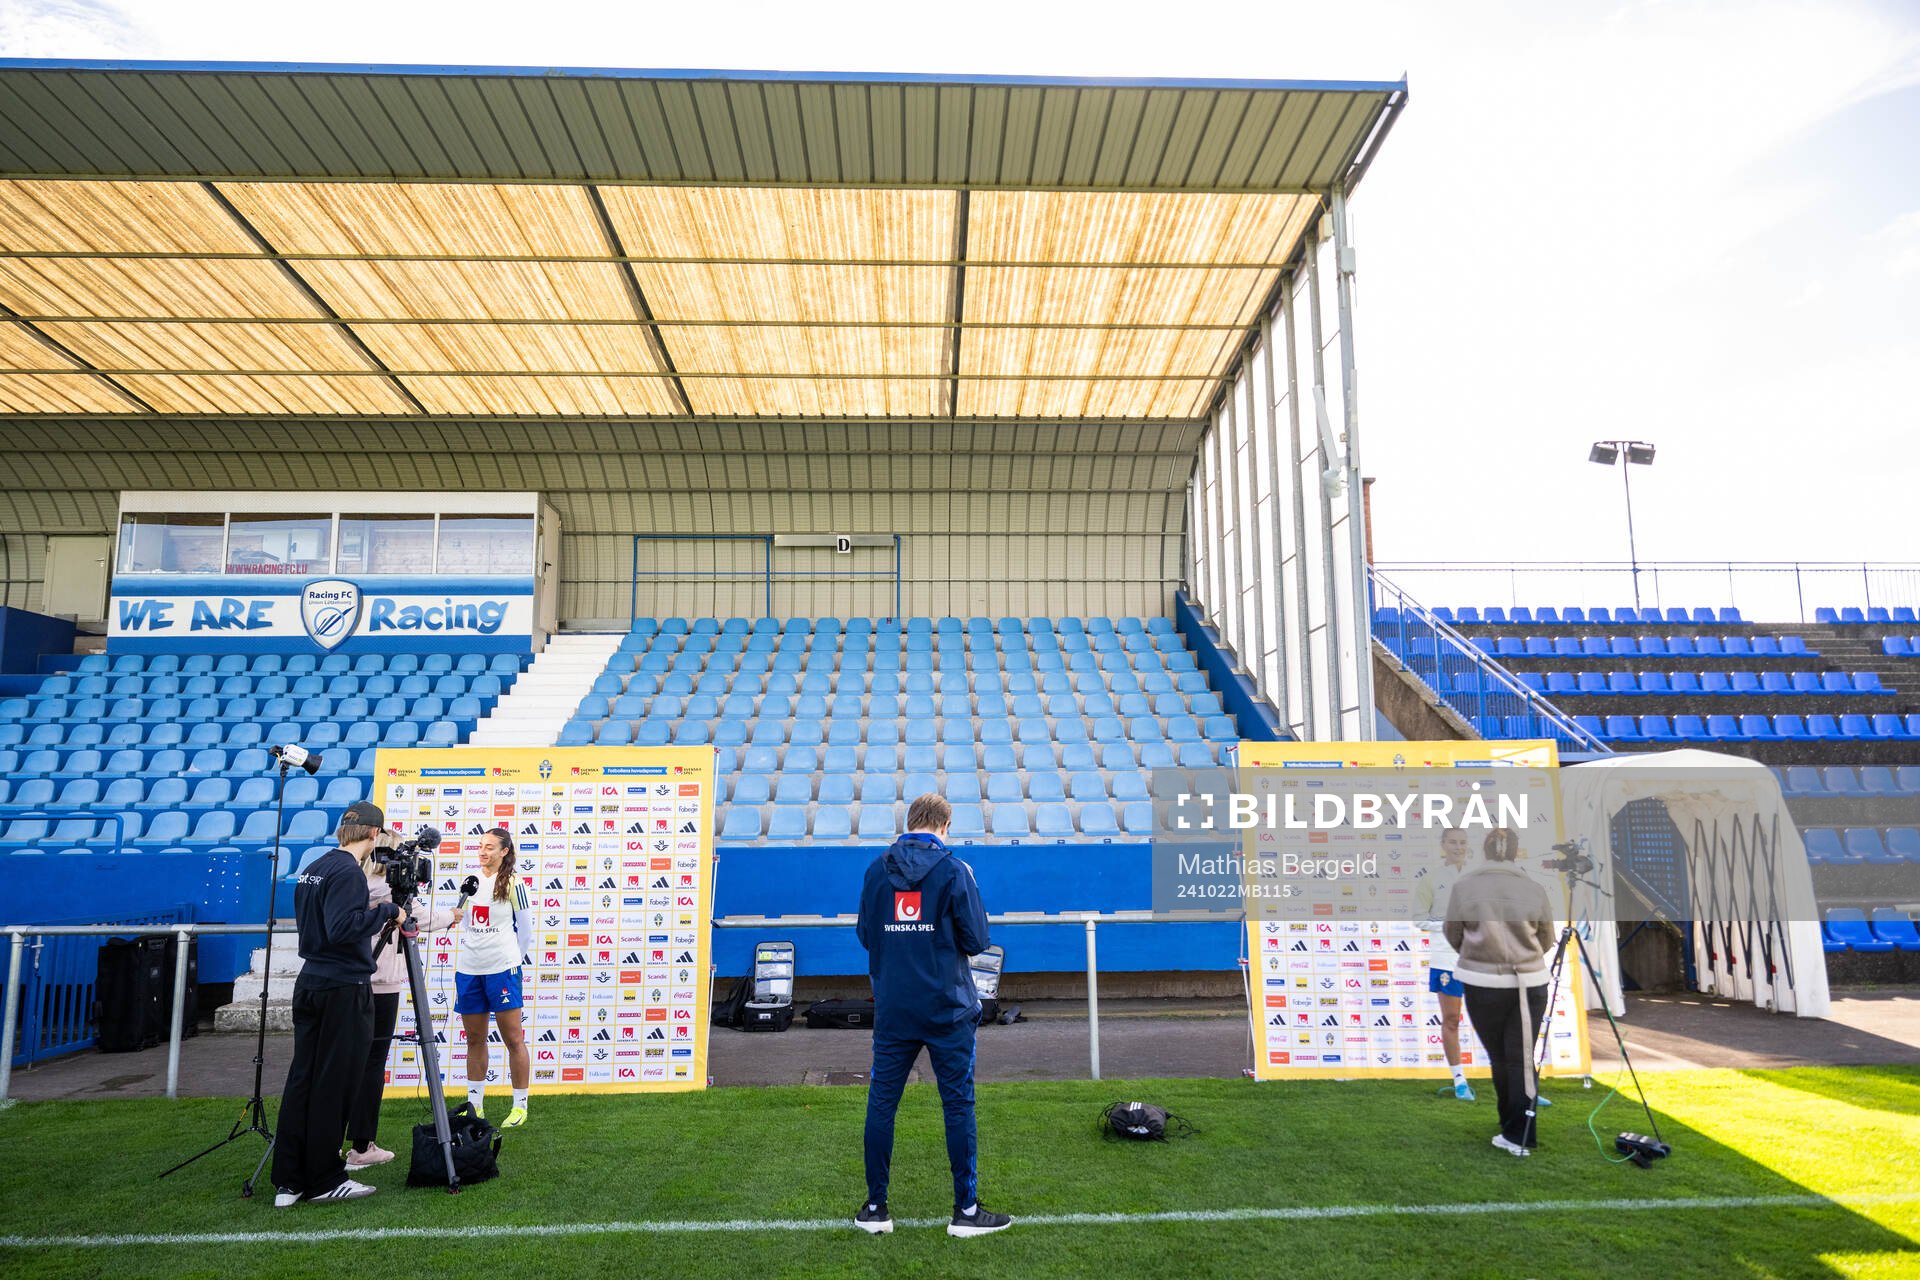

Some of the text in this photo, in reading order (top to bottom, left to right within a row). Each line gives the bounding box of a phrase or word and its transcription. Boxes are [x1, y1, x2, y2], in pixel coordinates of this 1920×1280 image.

[839, 538, 850, 551] D
[309, 591, 339, 600] Racing
[119, 597, 509, 634] WE ARE Racing
[602, 787, 618, 795] ICA
[627, 842, 643, 850] ICA
[544, 899, 560, 907] ICA
[678, 897, 694, 905] ICA
[884, 924, 916, 932] SVENSKA
[1317, 924, 1331, 932] ICA
[436, 937, 452, 945] ICA
[597, 935, 613, 944] ICA
[1346, 979, 1361, 987] ICA
[674, 1010, 690, 1019] ICA
[538, 1051, 554, 1059] ICA
[619, 1069, 635, 1077] ICA
